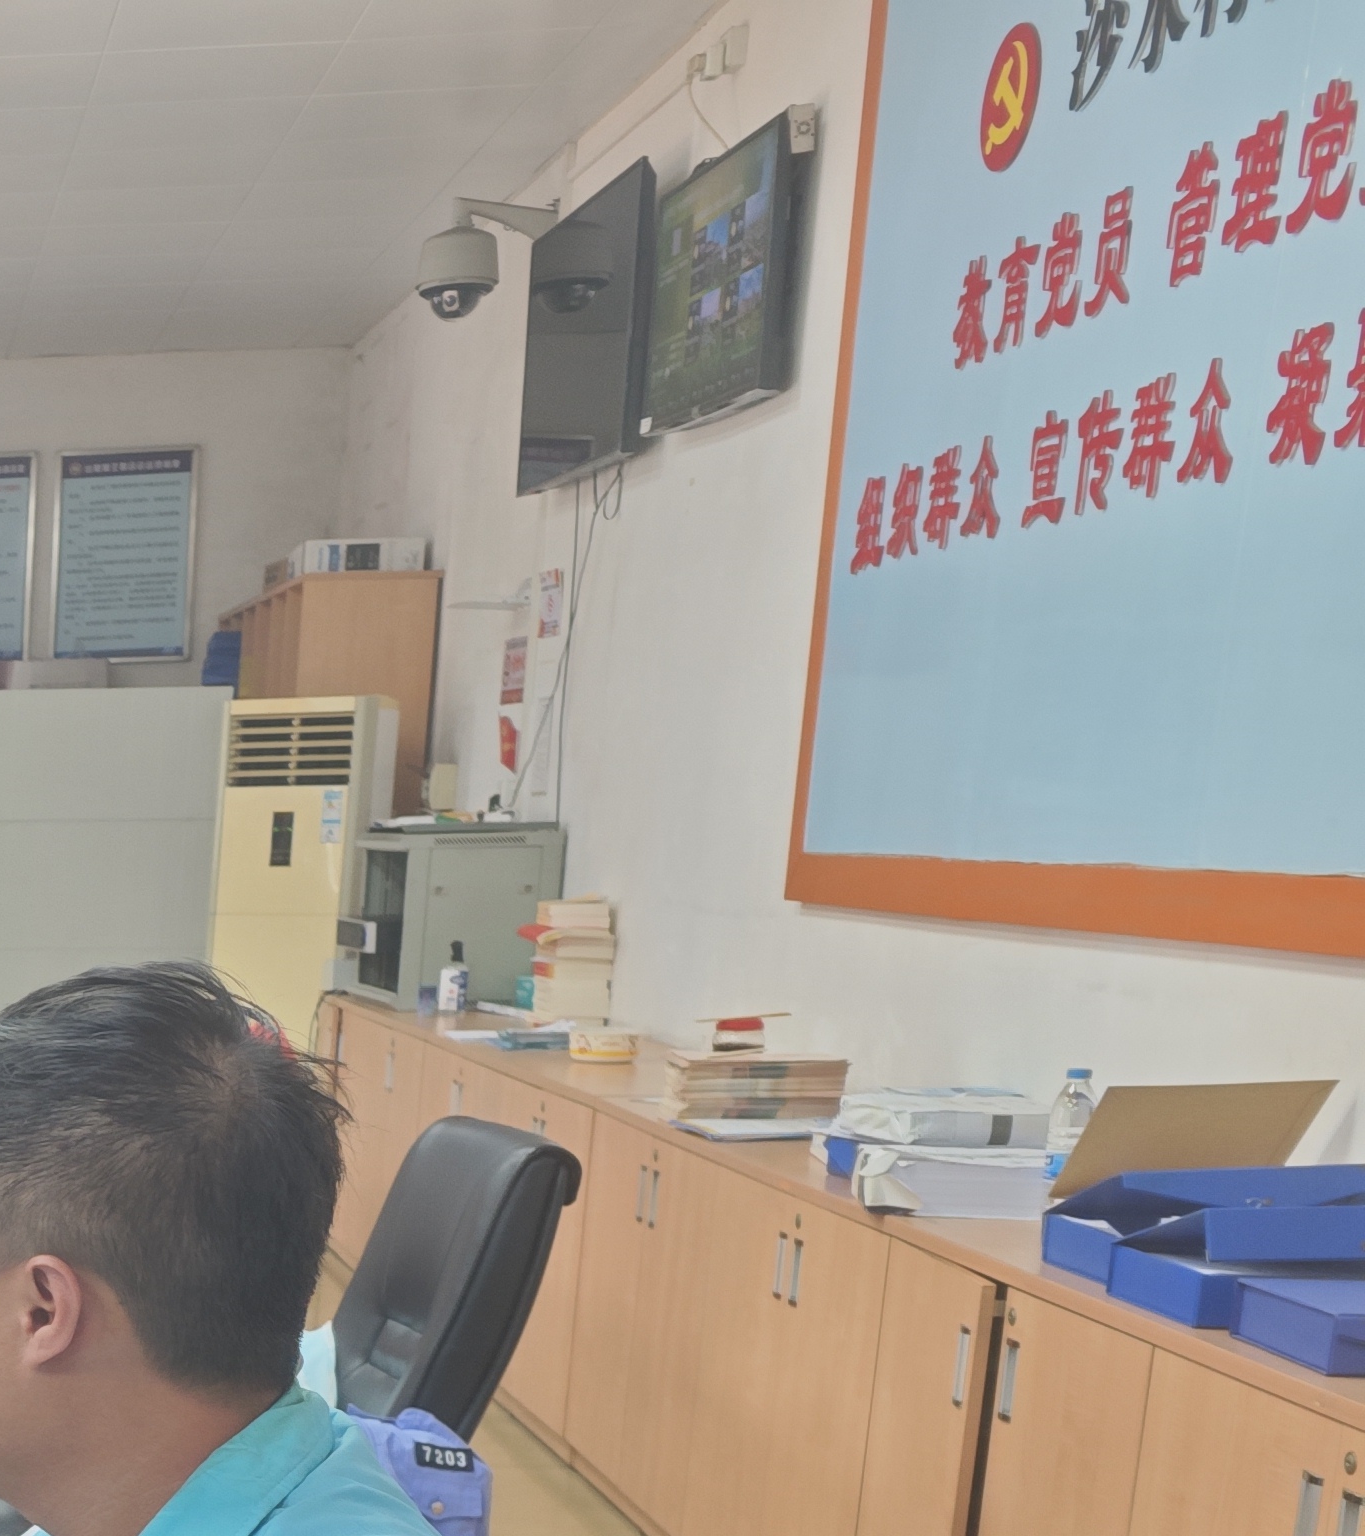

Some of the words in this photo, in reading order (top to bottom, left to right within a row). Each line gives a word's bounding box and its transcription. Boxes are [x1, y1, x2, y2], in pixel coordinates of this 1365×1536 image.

[953, 186, 1135, 370] 教育党员
[1167, 78, 1365, 288] 管理党
[850, 435, 1000, 575] 组织群众
[1021, 357, 1234, 529] 宣传群众
[421, 1445, 468, 1468] 7203
